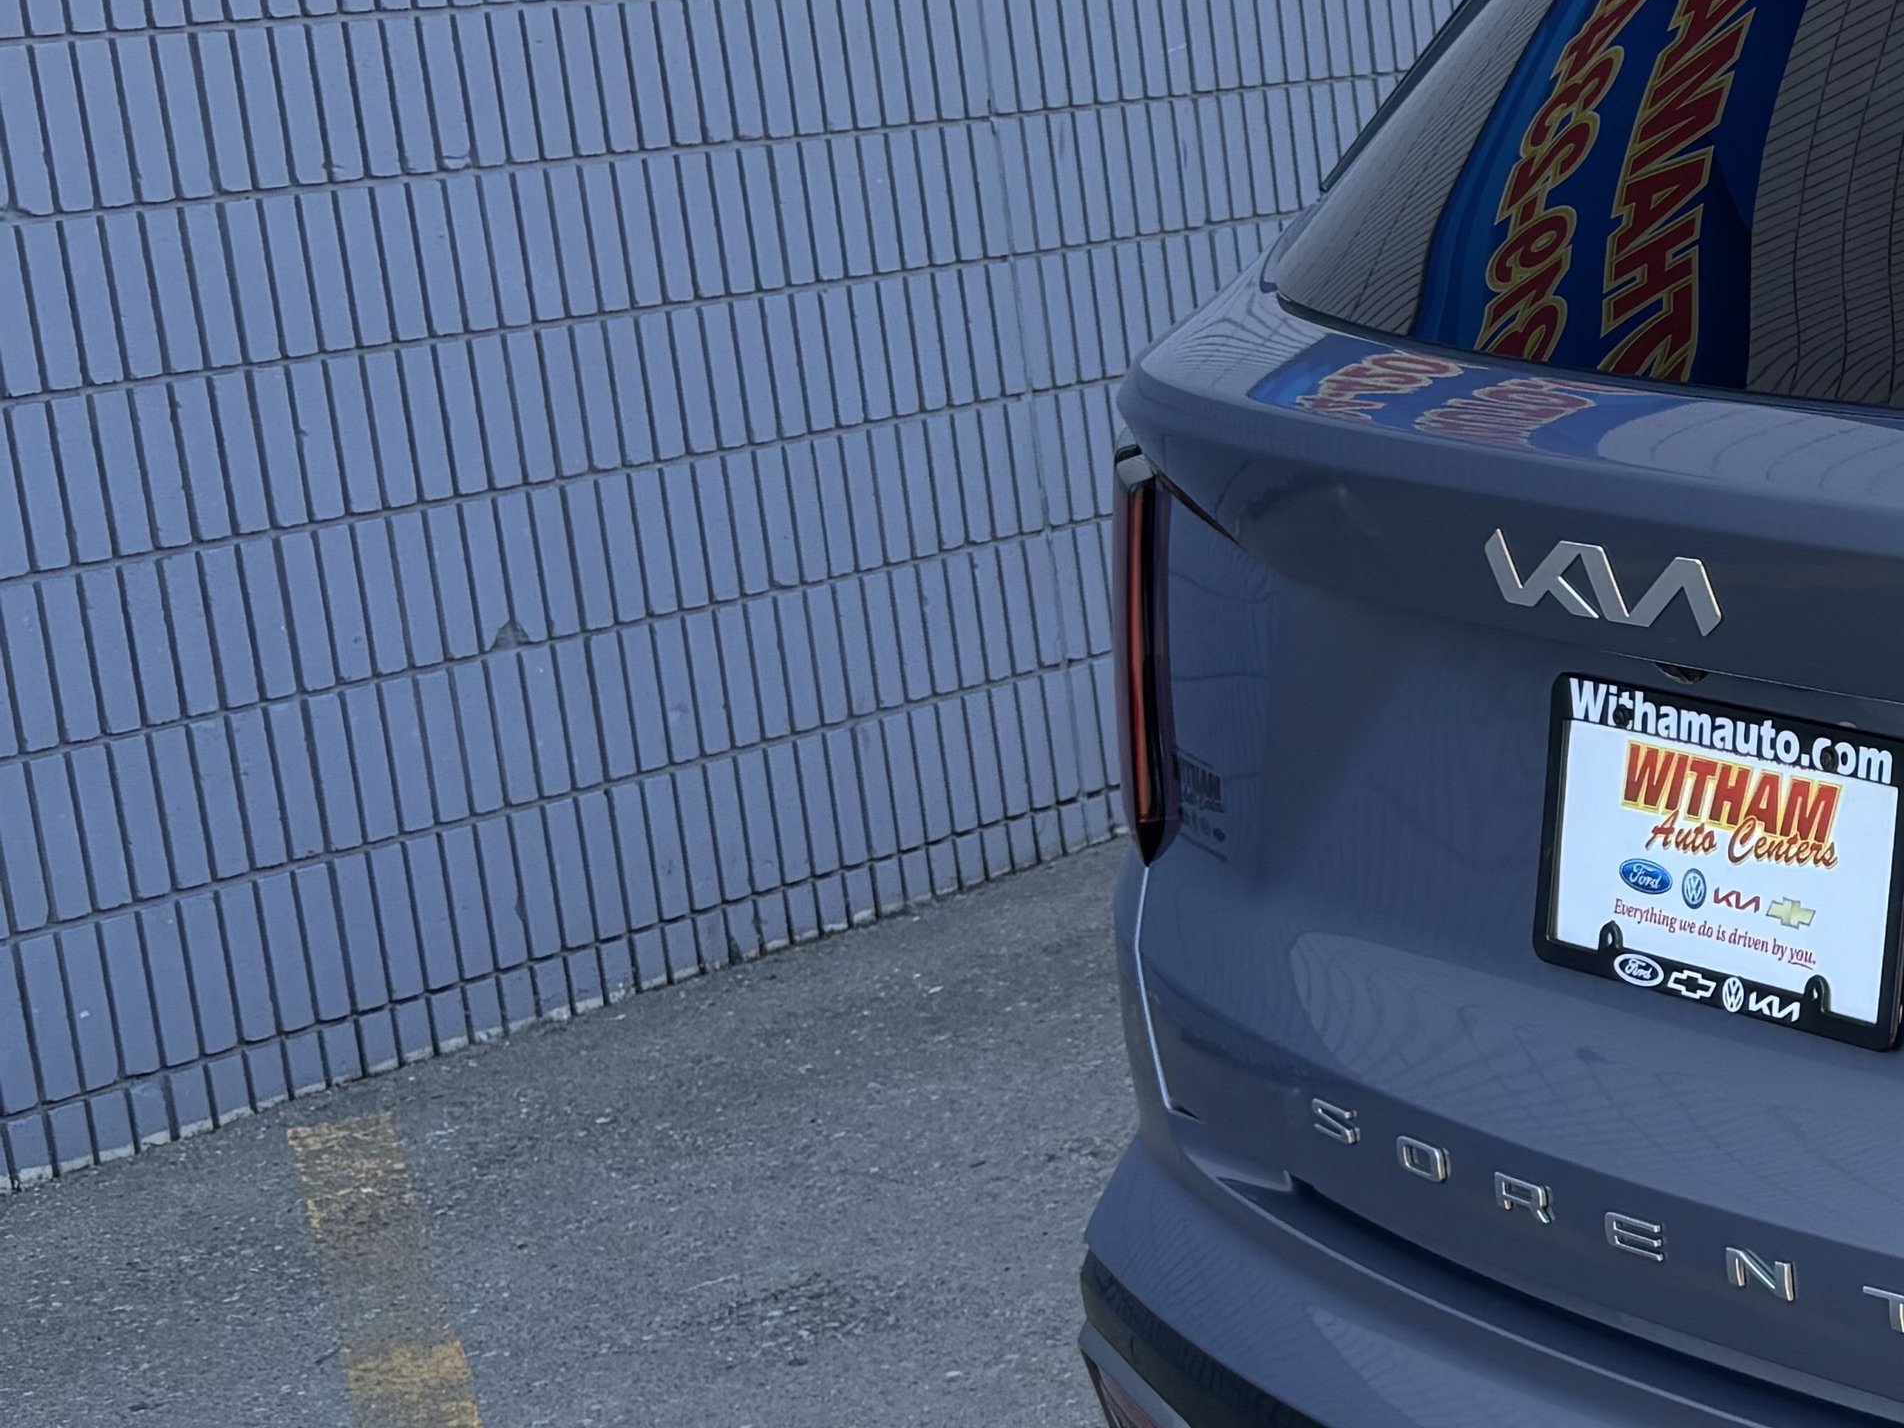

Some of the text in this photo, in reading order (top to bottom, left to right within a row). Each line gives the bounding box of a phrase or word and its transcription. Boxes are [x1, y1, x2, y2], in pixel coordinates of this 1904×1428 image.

[1484, 529, 1722, 637] KIA
[1568, 677, 1893, 785] Withamauto.com
[1621, 740, 1843, 844] WITHAM
[1645, 811, 1839, 869] Auto Centers
[1627, 861, 1663, 890] Ford
[1714, 887, 1761, 913] KIA
[1614, 898, 1817, 967] Everything we do is driven by you.
[1621, 956, 1656, 982] Ford
[1749, 991, 1800, 1022] KIA
